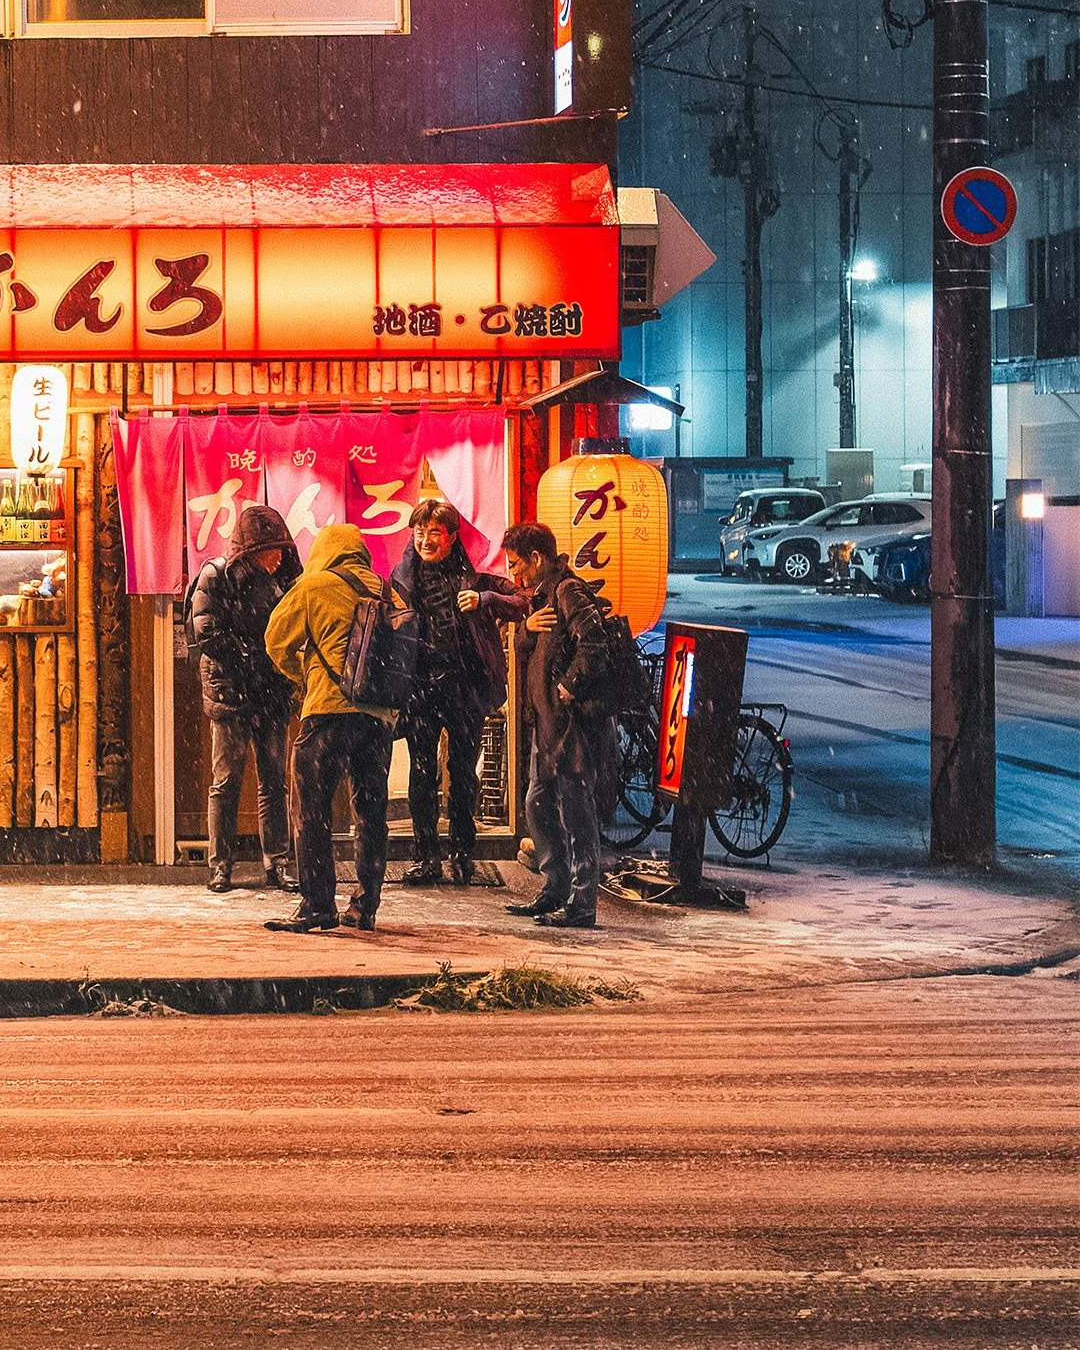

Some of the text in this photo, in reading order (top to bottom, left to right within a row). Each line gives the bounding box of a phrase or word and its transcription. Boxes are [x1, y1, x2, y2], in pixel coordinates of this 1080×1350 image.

[28, 376, 54, 463] 生ビール
[227, 444, 378, 473] 晩酌処
[631, 479, 650, 542] 晩酌処
